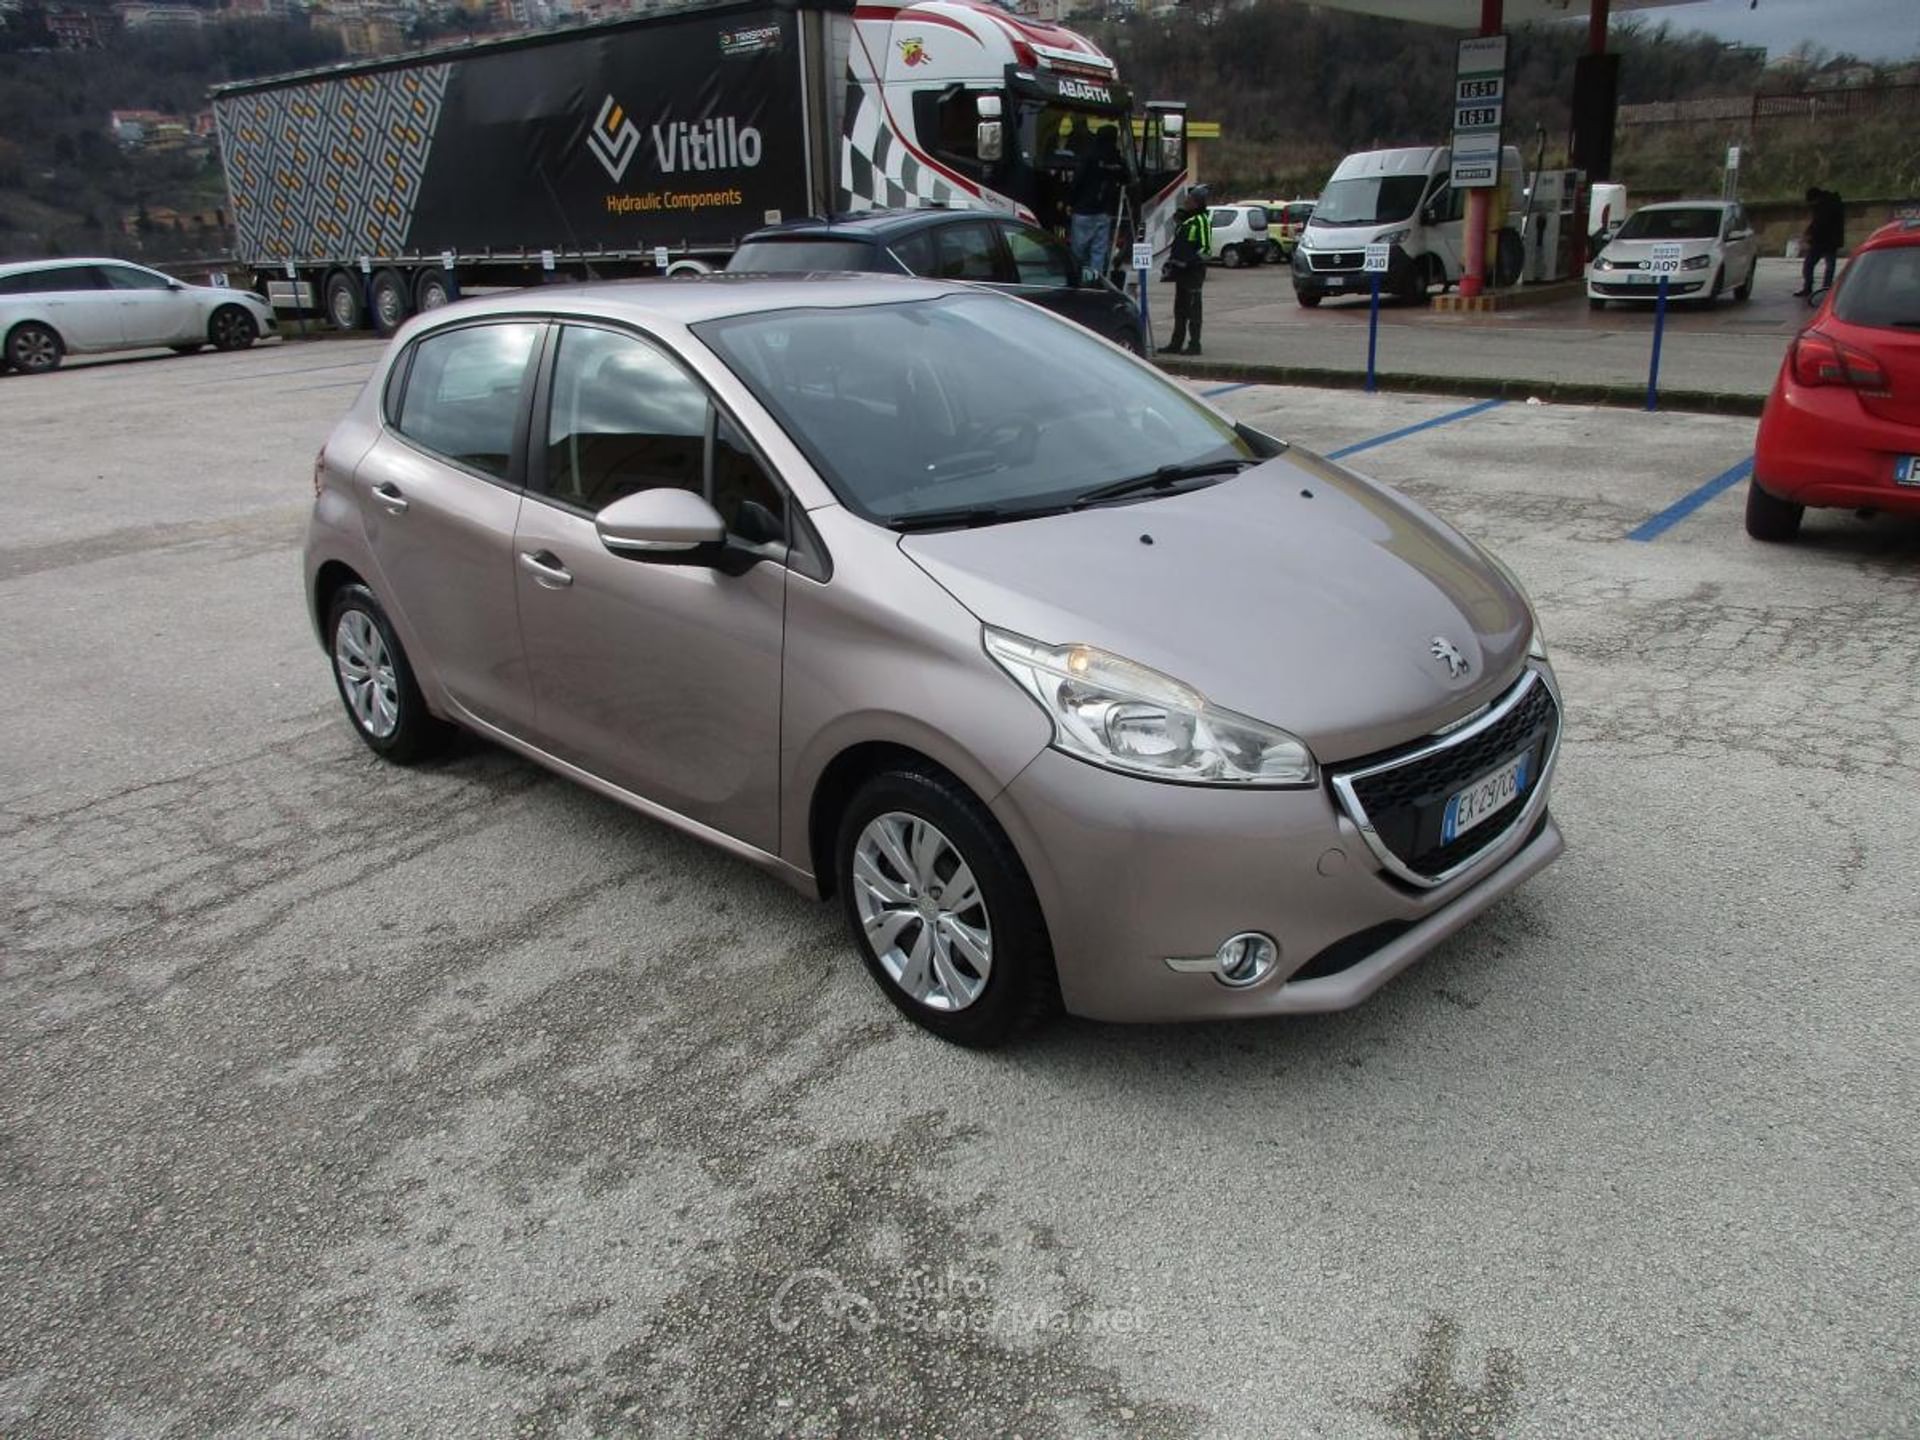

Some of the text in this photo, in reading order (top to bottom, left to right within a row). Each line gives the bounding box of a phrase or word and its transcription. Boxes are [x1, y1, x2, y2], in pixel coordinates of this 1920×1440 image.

[1058, 79, 1112, 103] ABARTH
[652, 117, 762, 173] Vitillo
[606, 188, 742, 215] Hydraulic Components
[1652, 260, 1679, 272] A09
